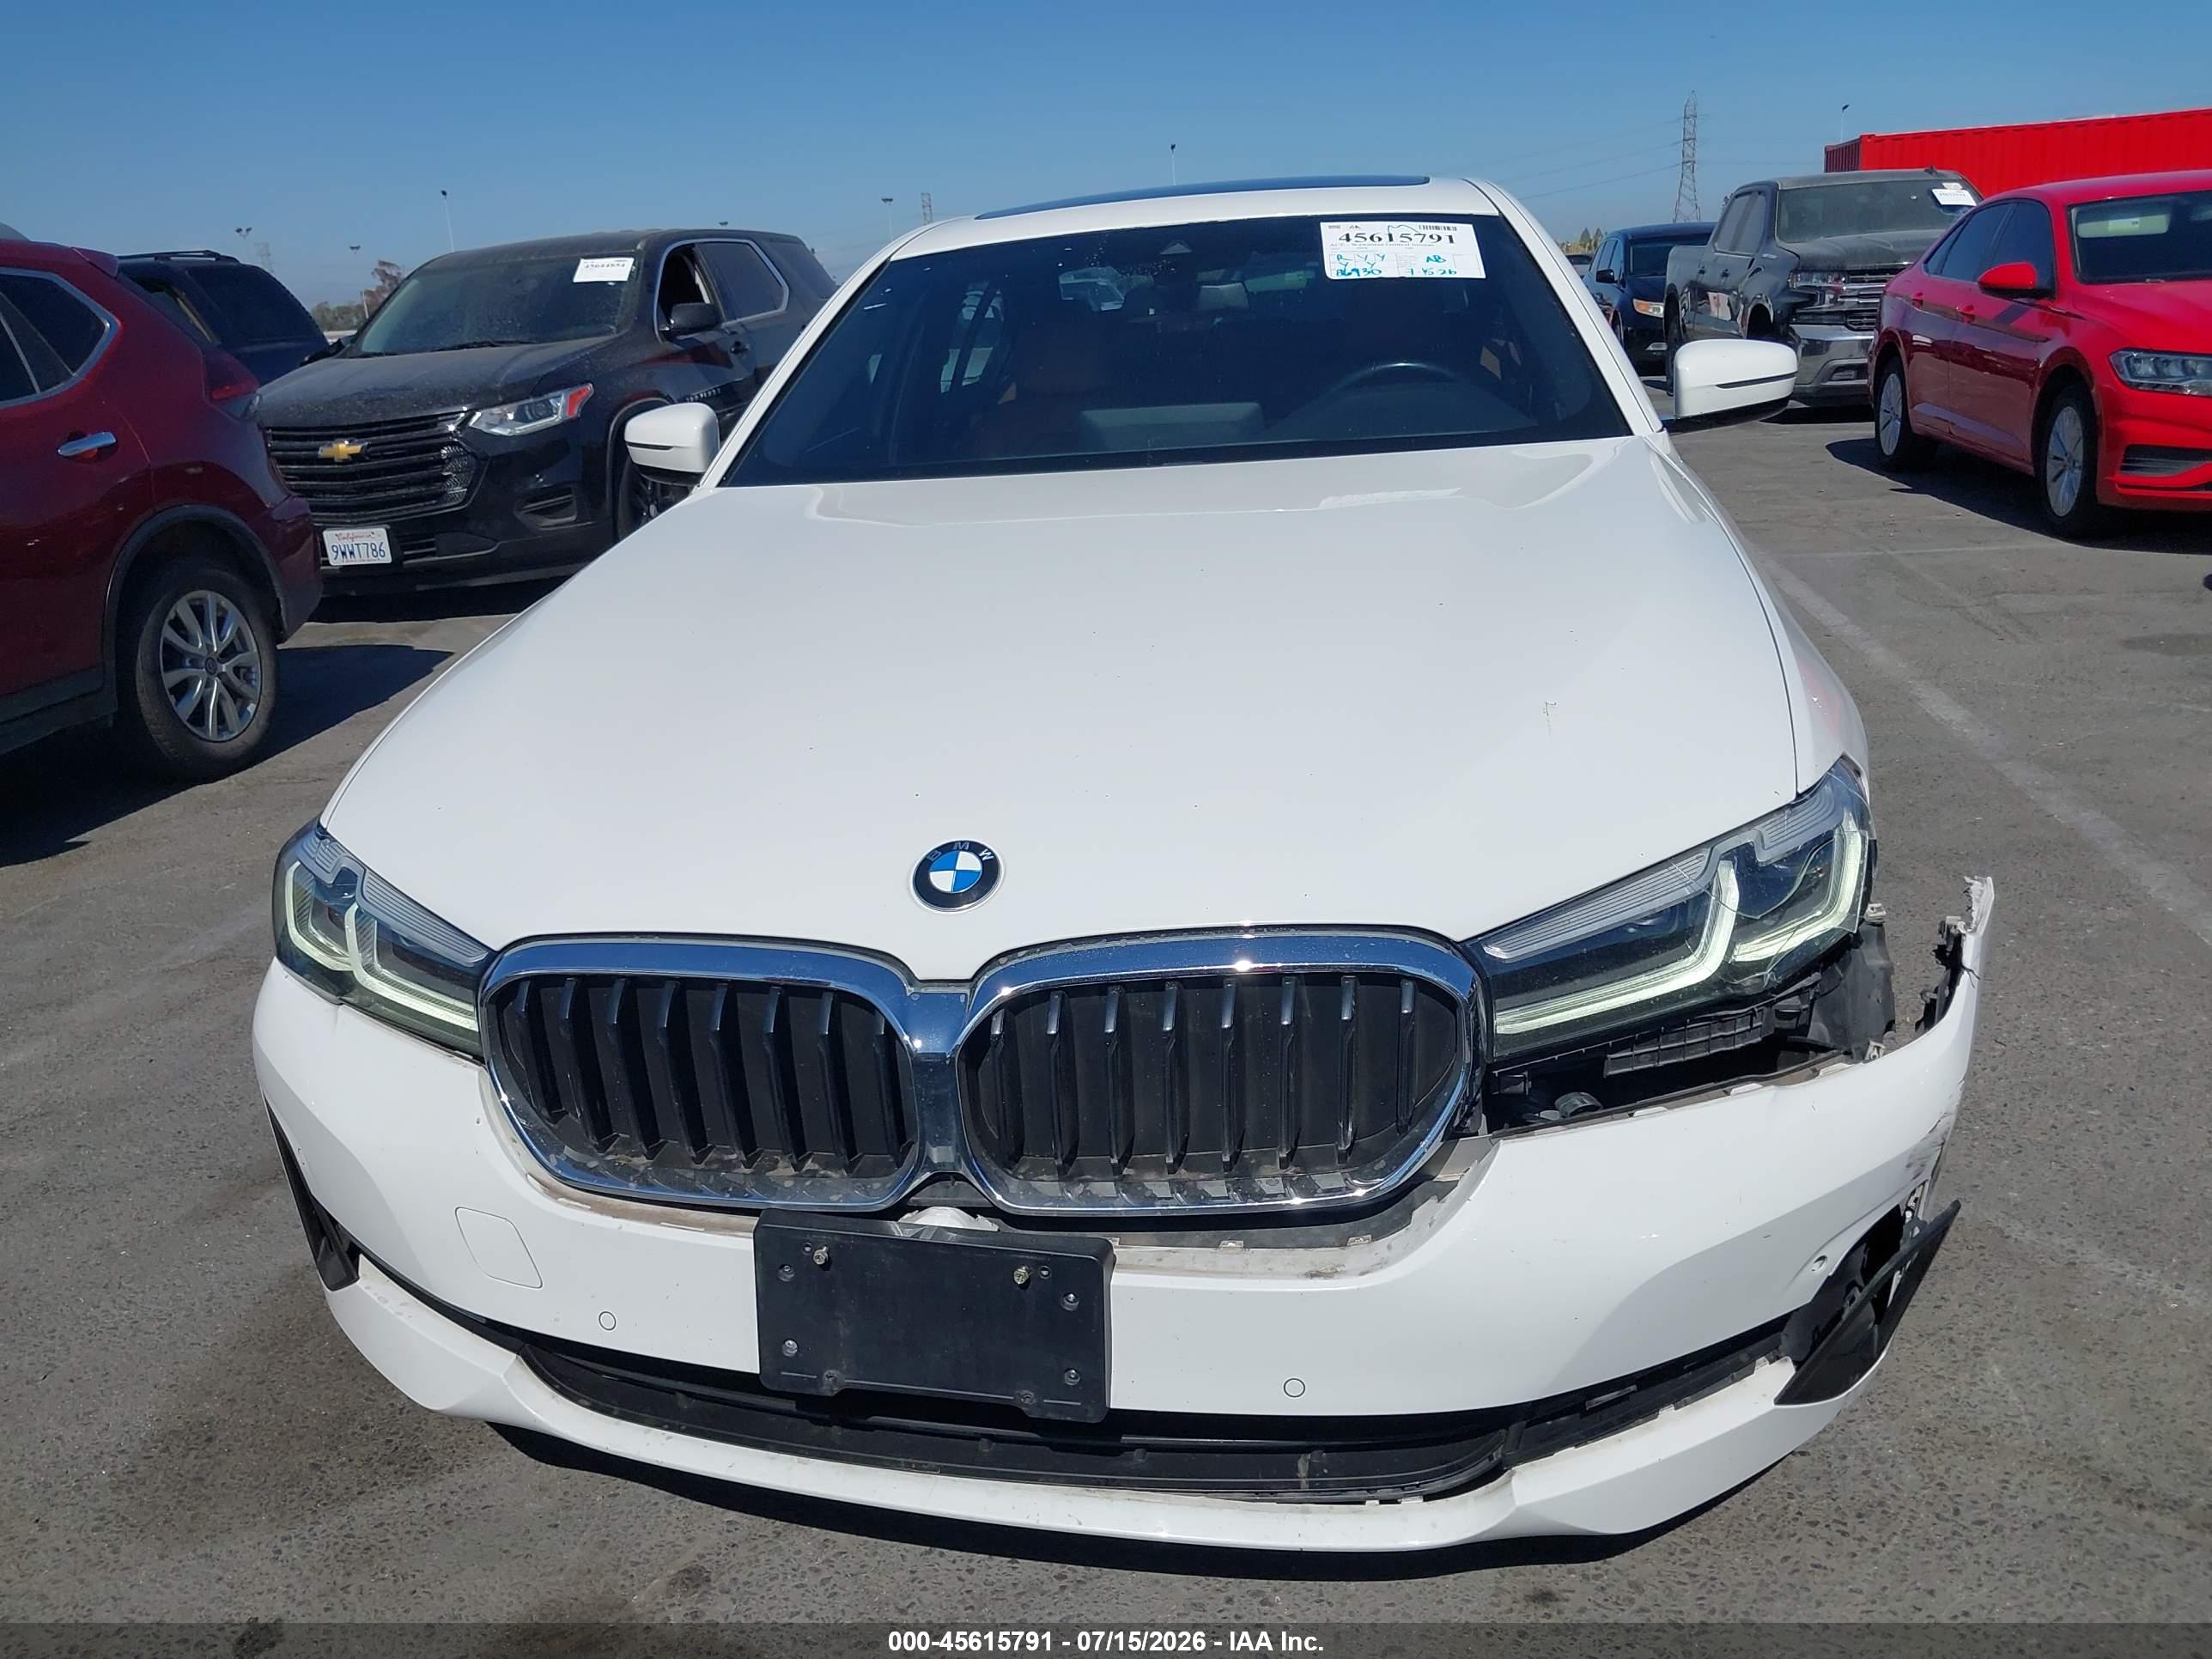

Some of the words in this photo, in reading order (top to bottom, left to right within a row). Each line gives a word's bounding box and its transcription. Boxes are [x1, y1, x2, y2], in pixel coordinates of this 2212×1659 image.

[1338, 232, 1455, 245] 45615791
[331, 541, 386, 561] 9WWT786
[926, 841, 996, 862] BMW
